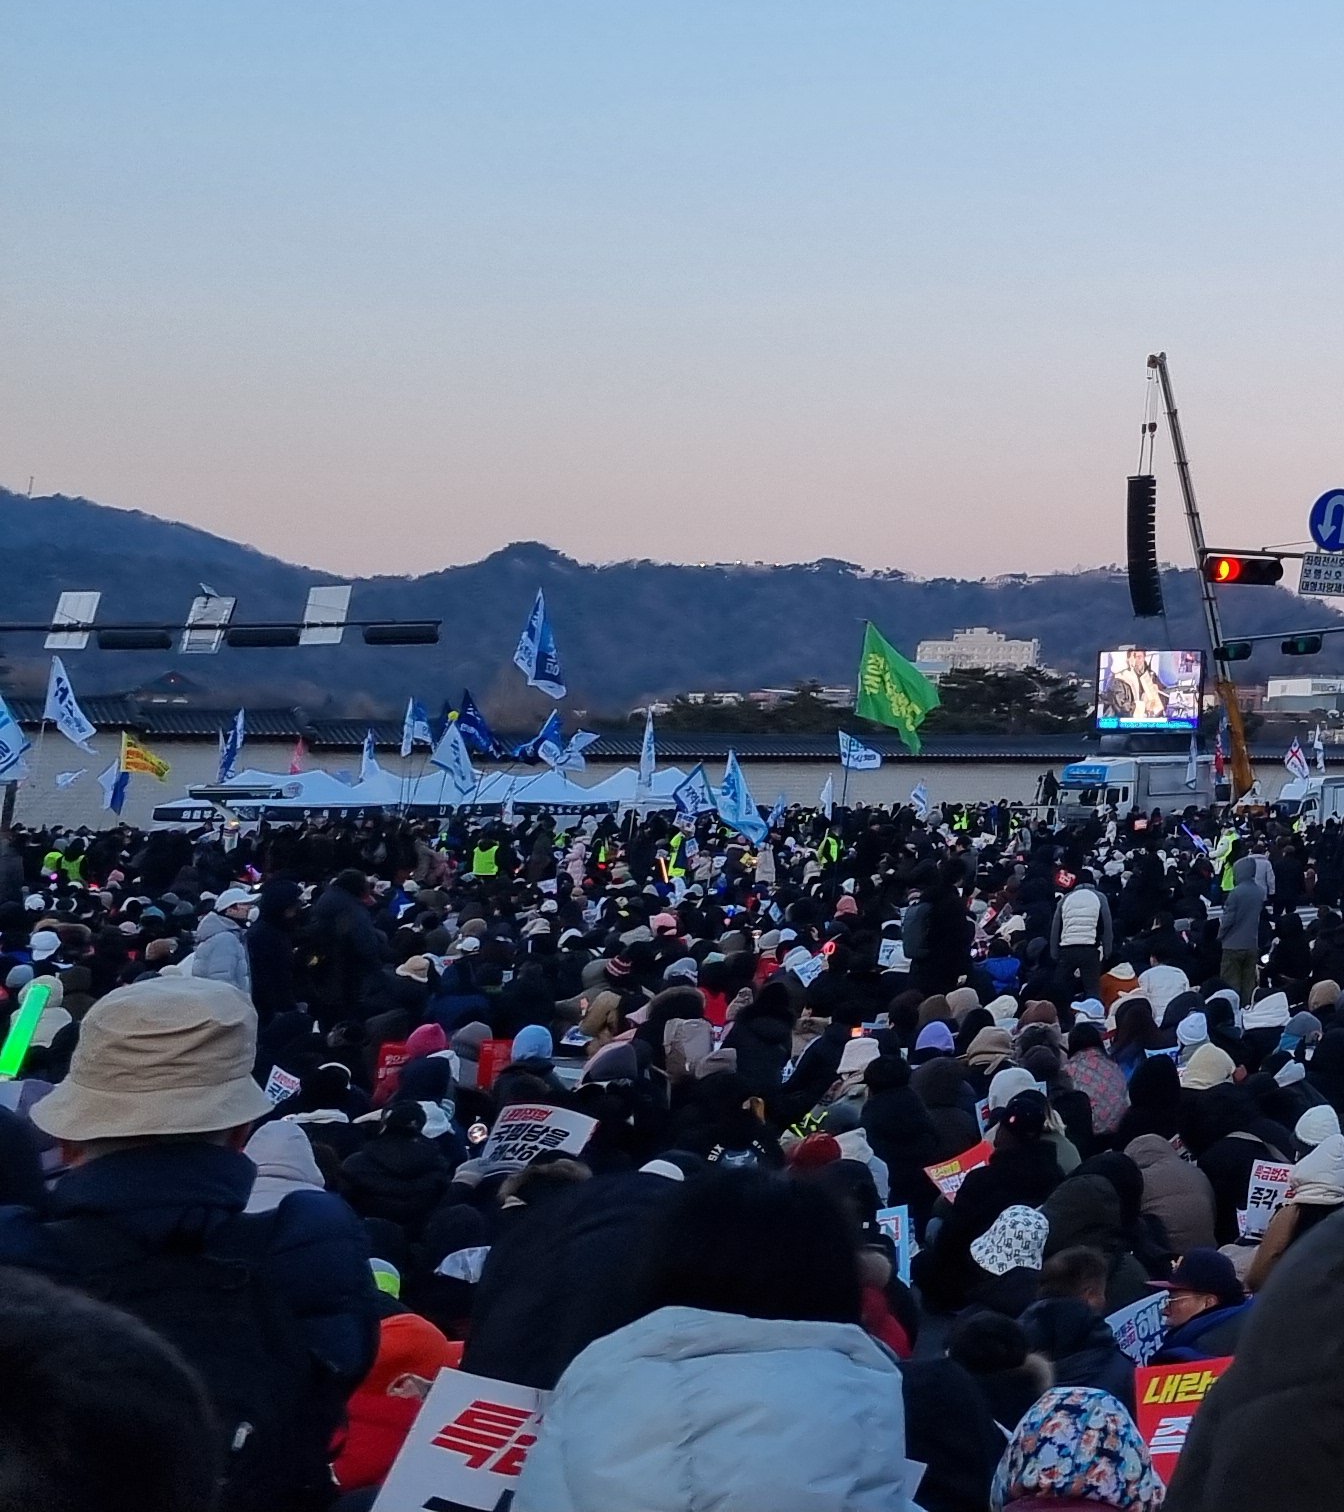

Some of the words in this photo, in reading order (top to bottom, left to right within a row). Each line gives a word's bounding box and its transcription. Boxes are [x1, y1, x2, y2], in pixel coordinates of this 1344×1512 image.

[495, 1123, 571, 1149] 국힘당을
[490, 1143, 546, 1162] 해산하
[1251, 1187, 1277, 1210] 즉각
[1142, 1371, 1219, 1405] 내란
